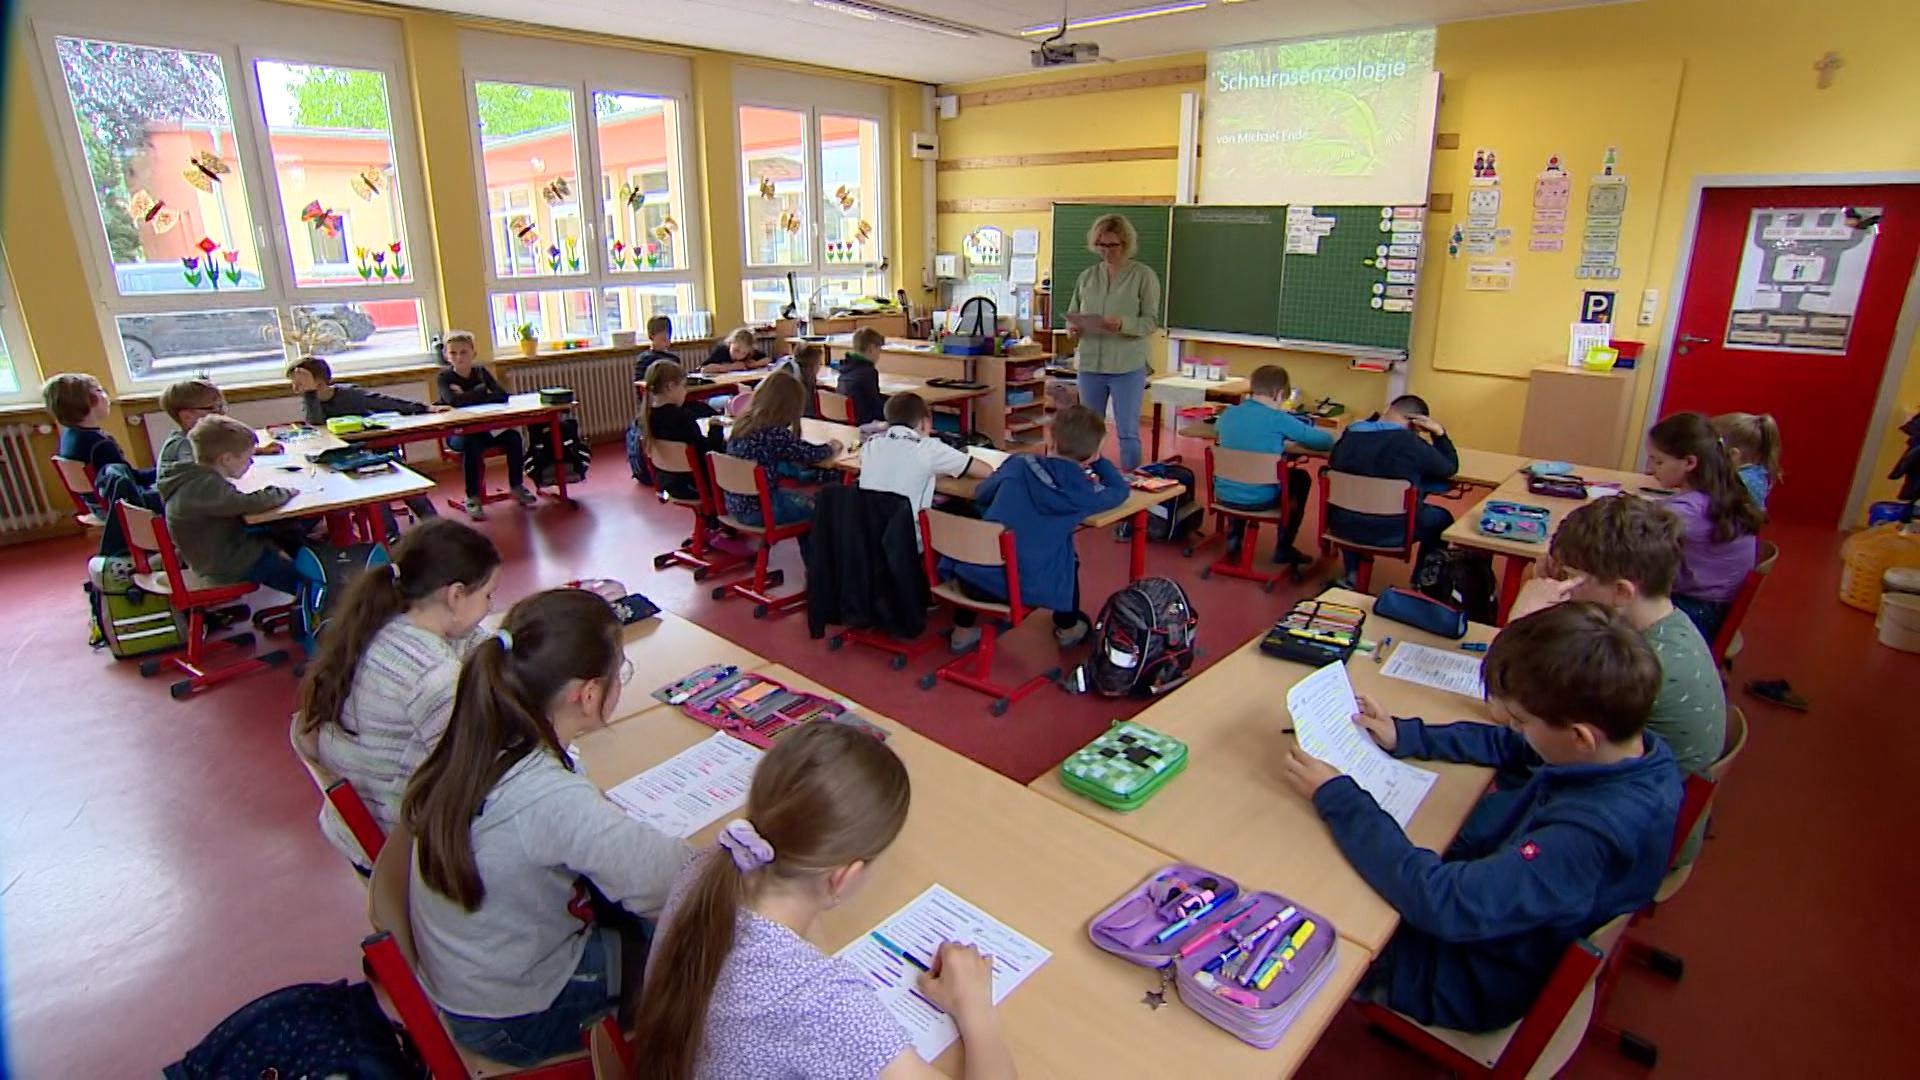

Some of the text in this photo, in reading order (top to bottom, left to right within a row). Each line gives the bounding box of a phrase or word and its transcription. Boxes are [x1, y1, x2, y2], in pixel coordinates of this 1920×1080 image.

[1216, 134, 1236, 145] von
[1237, 130, 1280, 144] Michael
[1586, 295, 1609, 320] P
